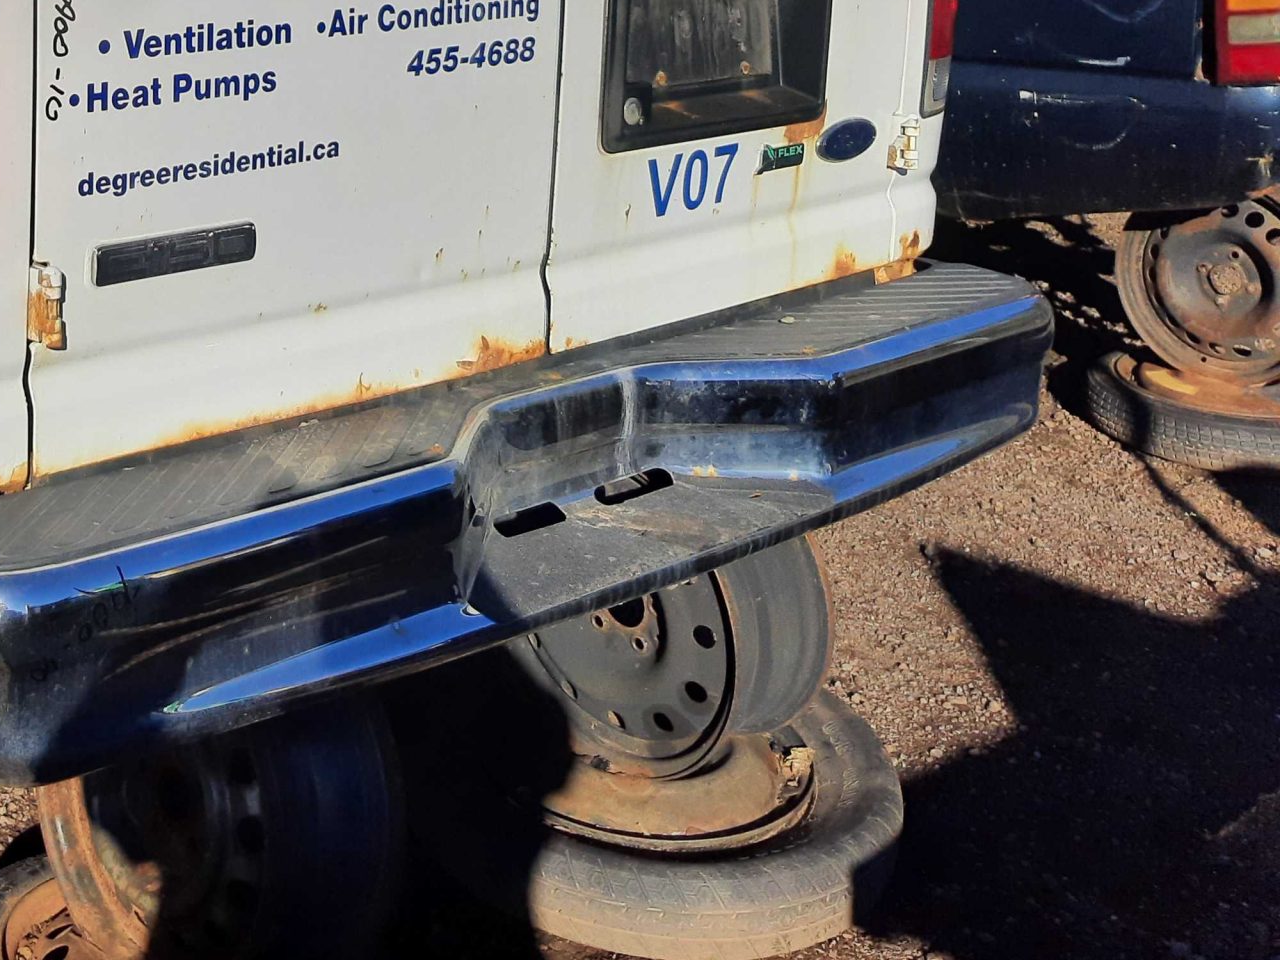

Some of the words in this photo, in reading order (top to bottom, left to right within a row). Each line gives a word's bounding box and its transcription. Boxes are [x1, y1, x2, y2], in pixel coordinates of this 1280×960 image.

[123, 20, 292, 59] Ventilation
[328, 7, 368, 38] Air
[407, 36, 536, 76] 455-4688
[86, 77, 162, 113] Heat
[173, 69, 277, 102] Pumps
[77, 140, 340, 197] degreeresidential.ca
[778, 144, 803, 158] FLEX
[647, 142, 739, 217] V07
